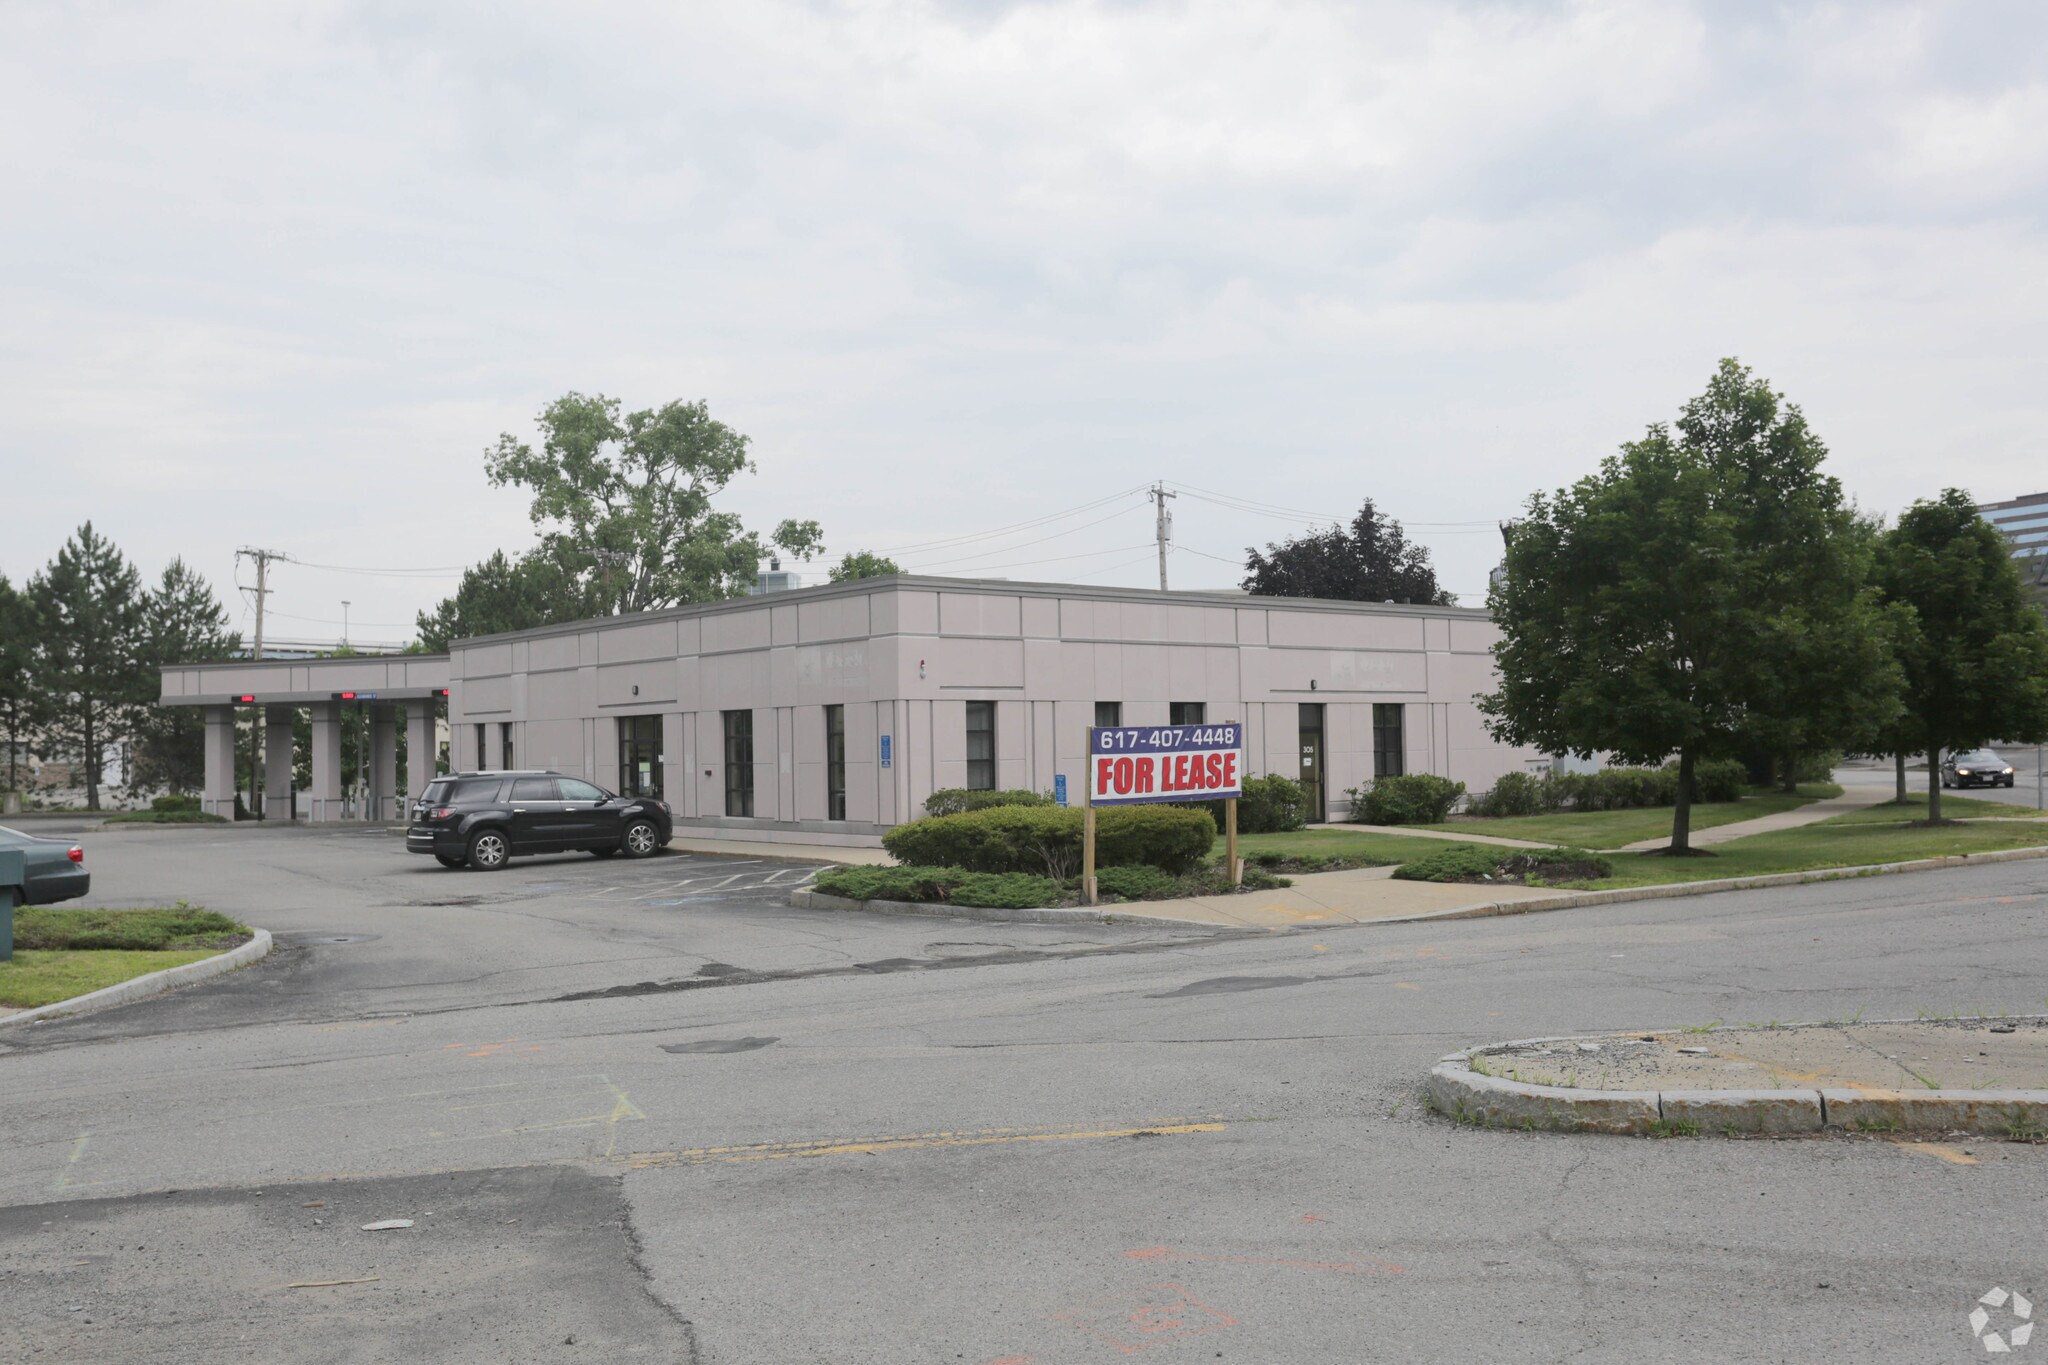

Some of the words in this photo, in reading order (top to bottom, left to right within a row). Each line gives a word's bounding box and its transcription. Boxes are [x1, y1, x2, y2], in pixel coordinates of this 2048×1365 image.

[1101, 728, 1234, 749] 617-407-4448
[1098, 757, 1154, 795] FOR
[1161, 753, 1236, 791] LEASE
